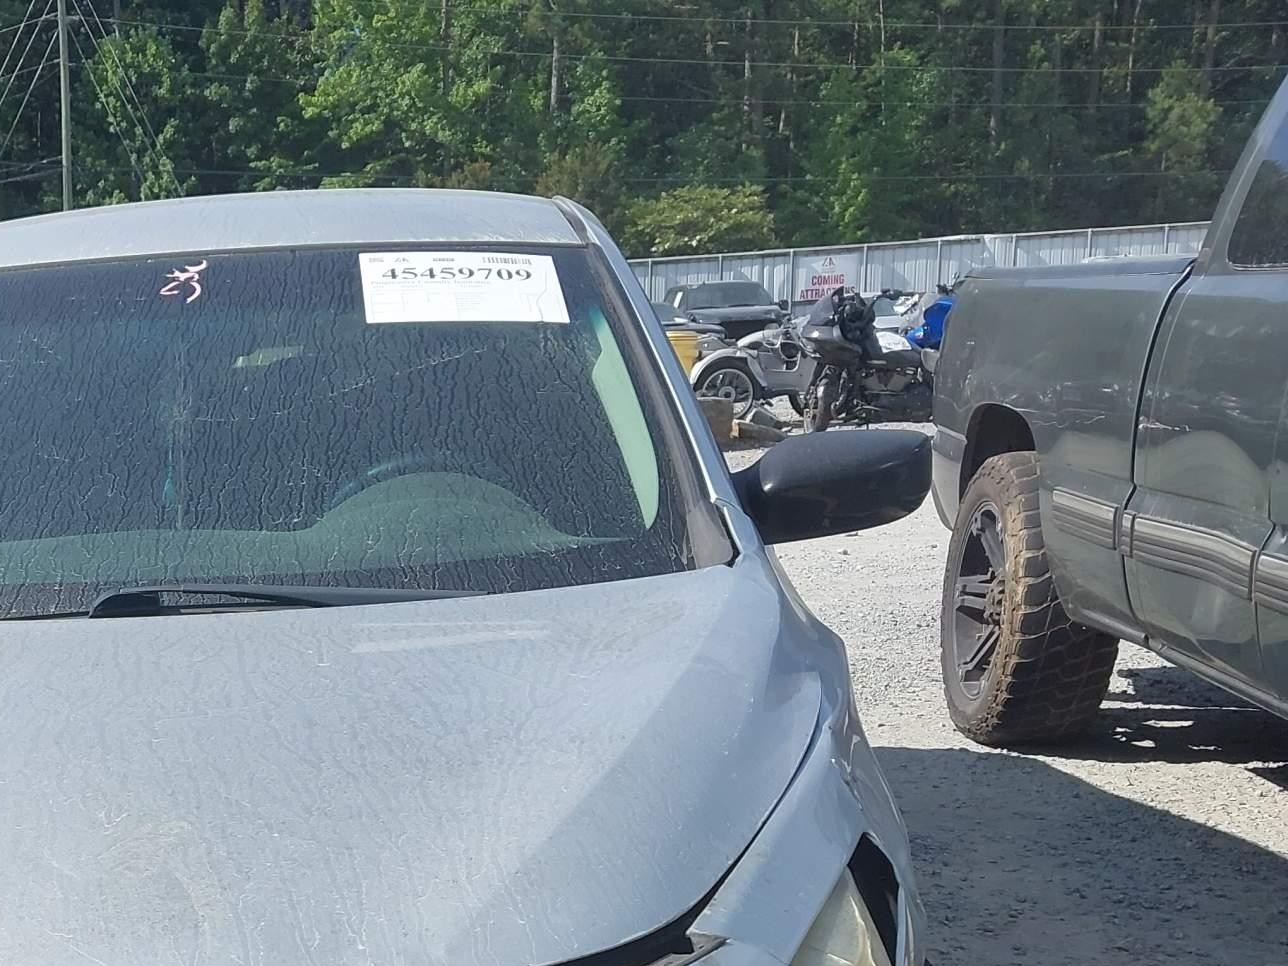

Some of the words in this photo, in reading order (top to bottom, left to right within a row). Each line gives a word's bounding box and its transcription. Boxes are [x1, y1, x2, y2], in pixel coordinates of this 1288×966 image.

[382, 266, 533, 281] 45459709
[811, 274, 845, 286] COMING
[799, 286, 856, 300] ATTRACNS
